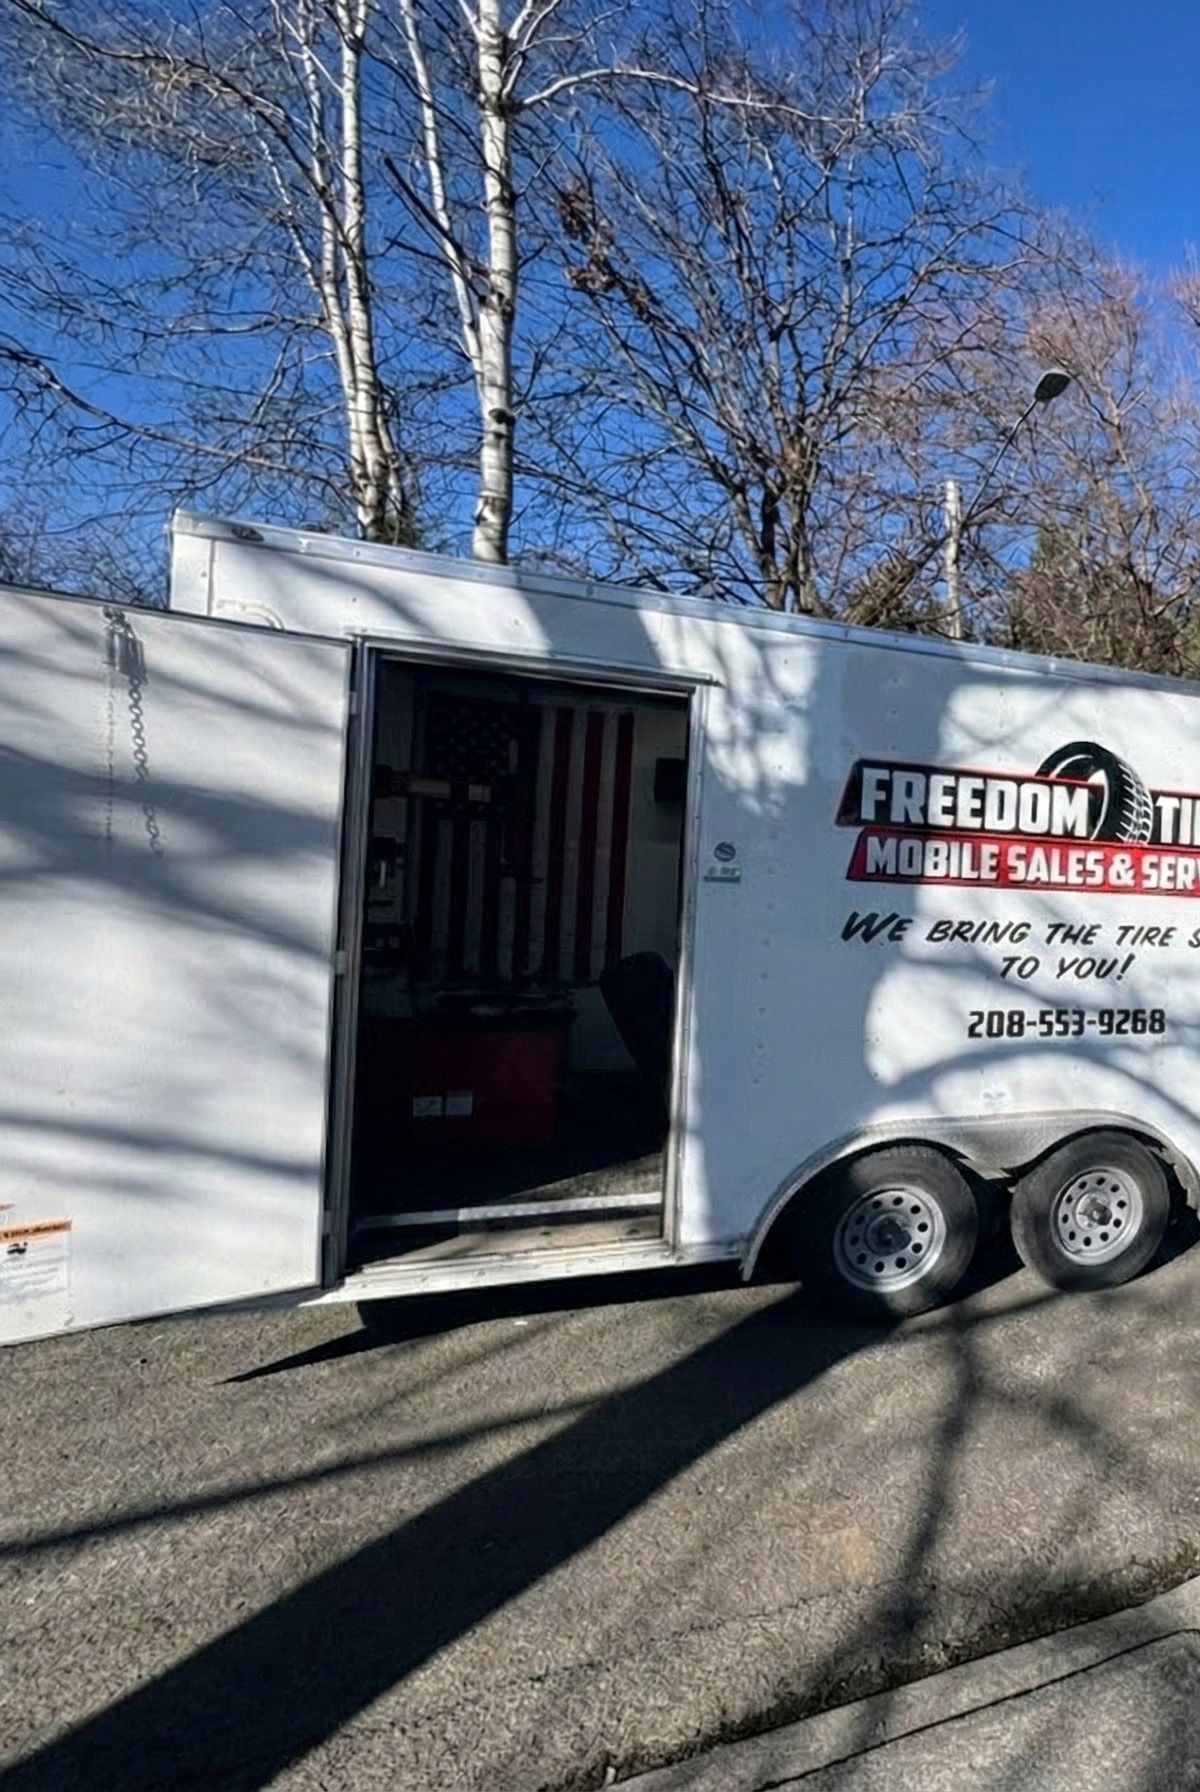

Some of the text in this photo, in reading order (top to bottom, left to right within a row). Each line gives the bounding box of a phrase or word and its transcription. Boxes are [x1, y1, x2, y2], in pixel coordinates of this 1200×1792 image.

[859, 767, 1090, 838] FREEDOM
[866, 836, 999, 880] MOBILE
[1007, 847, 1101, 885] SALES
[1108, 854, 1135, 888] &
[840, 912, 913, 944] WE
[926, 920, 1029, 945] BRING
[1046, 923, 1101, 946] THE
[1116, 925, 1176, 948] TIRE
[1000, 953, 1135, 981] TO YOU!
[967, 1009, 1166, 1039] 208-553-9268
